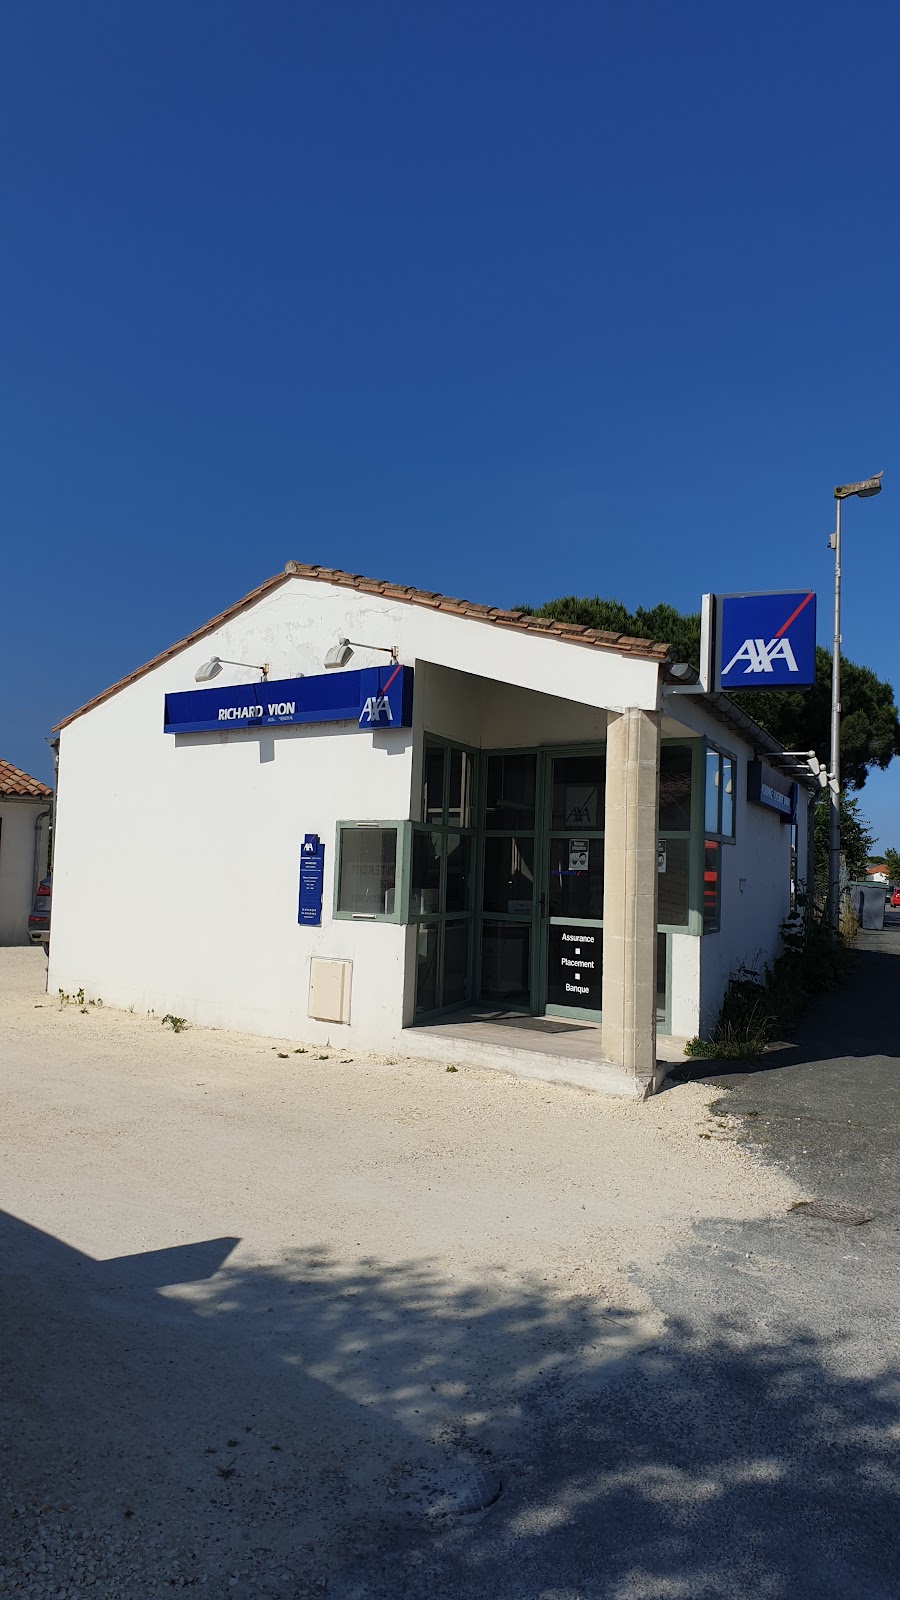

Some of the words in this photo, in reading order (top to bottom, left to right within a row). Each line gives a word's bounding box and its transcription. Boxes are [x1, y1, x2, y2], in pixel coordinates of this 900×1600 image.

[721, 638, 799, 675] AXA
[218, 705, 263, 721] RICHARD
[267, 701, 296, 716] VION
[359, 696, 394, 723] AXA
[565, 806, 591, 822] AXA
[562, 932, 595, 943] Assurance
[561, 957, 595, 969] Placement
[565, 982, 590, 995] Banque
